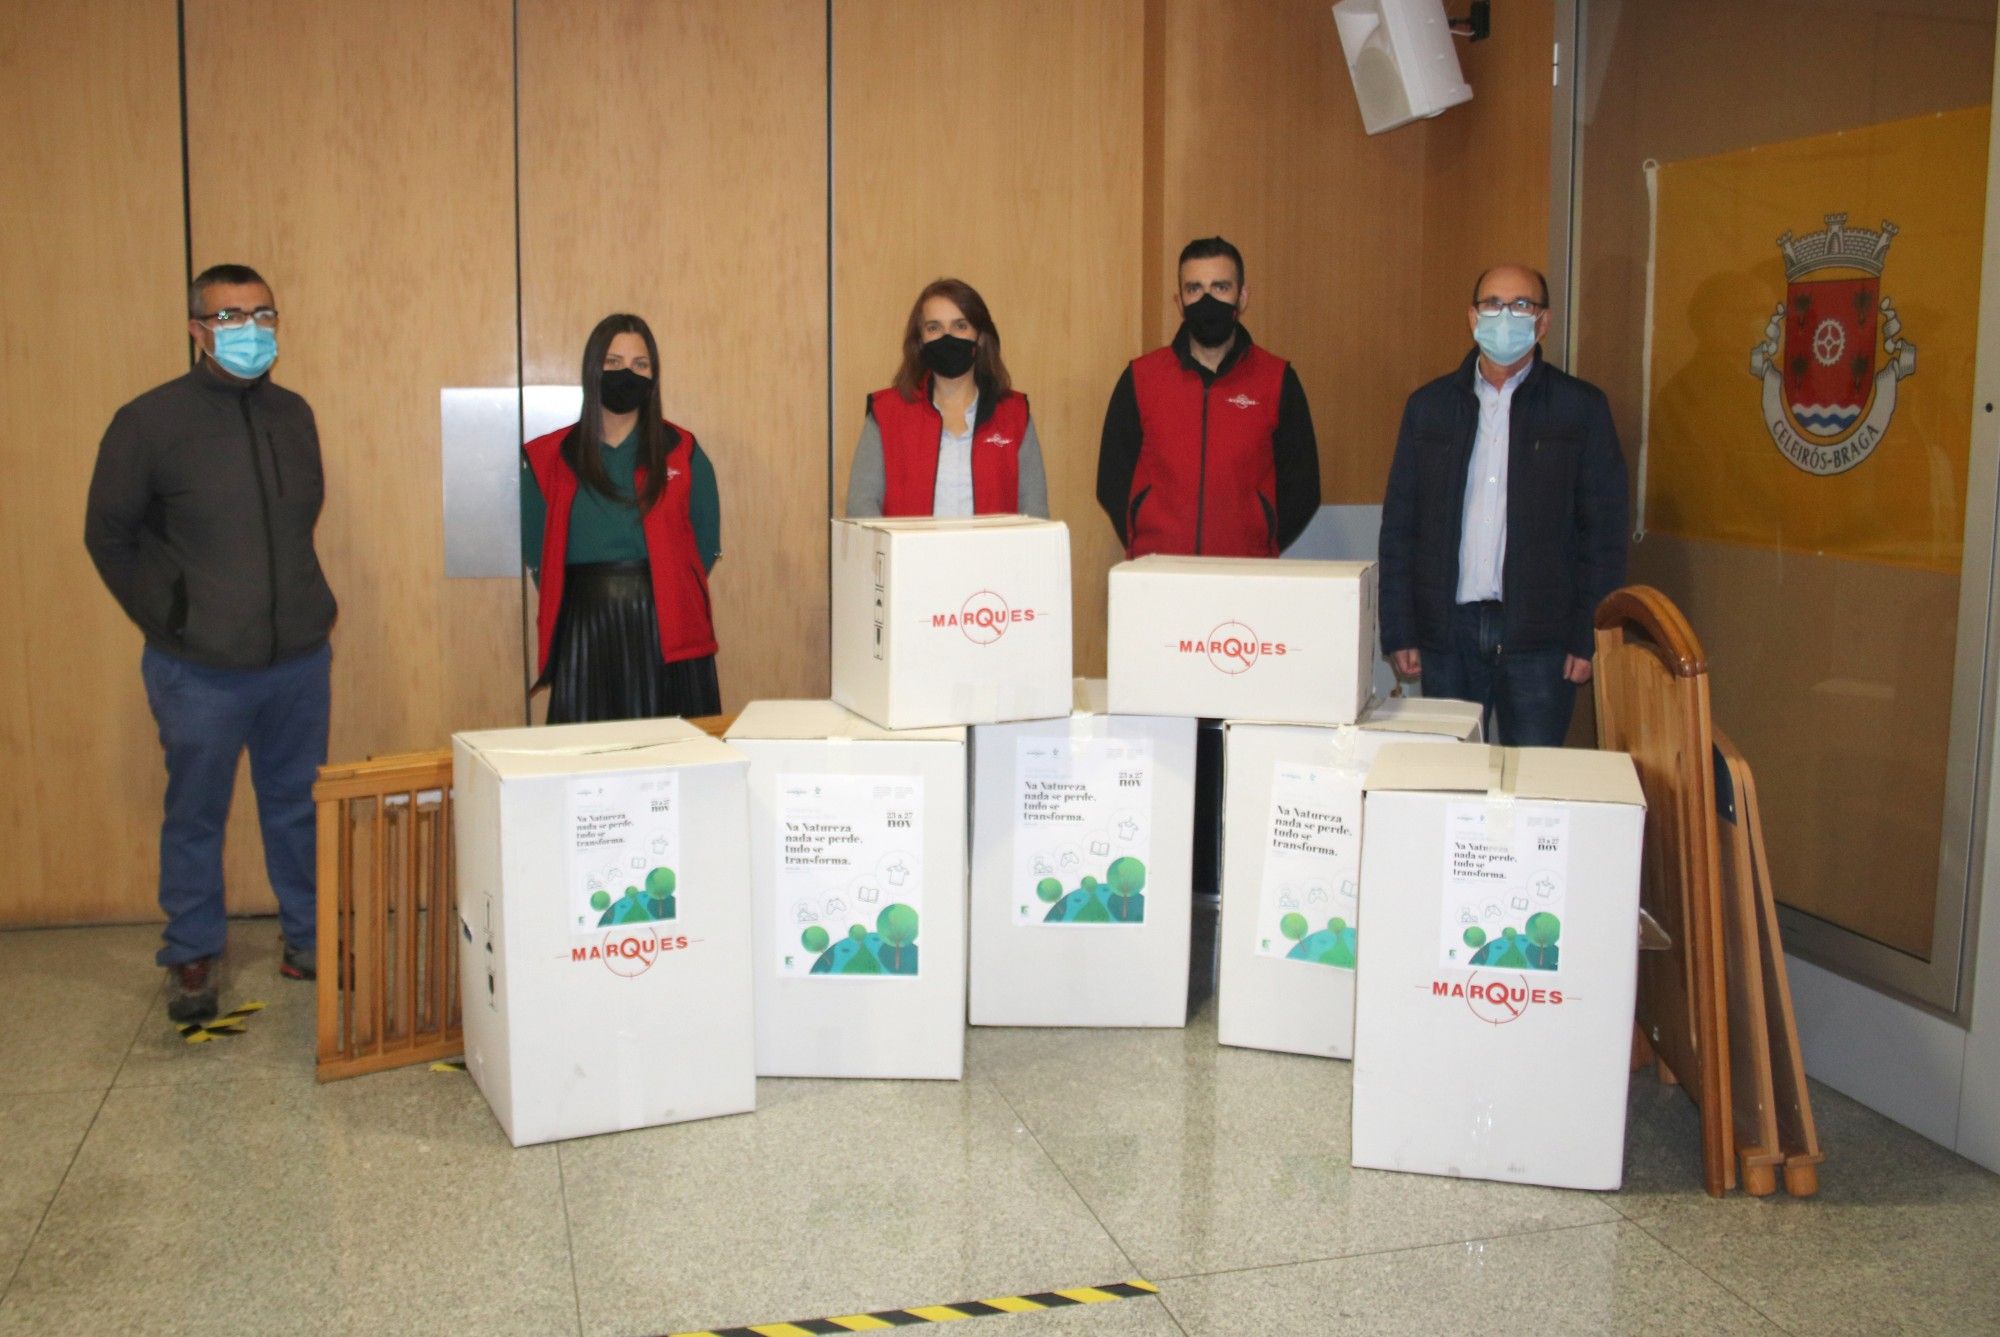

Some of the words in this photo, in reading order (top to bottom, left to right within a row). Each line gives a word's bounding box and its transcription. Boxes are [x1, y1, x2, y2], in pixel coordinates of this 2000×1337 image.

[932, 607, 1035, 636] MARQUES
[1179, 637, 1287, 667] MARQUES
[1025, 781, 1037, 790] Na
[1041, 782, 1086, 791] Natureza
[1119, 779, 1142, 787] nov
[1024, 791, 1049, 800] nada
[1024, 801, 1047, 810] tudo
[1277, 804, 1290, 816] Na
[1294, 807, 1342, 823] Natureza
[785, 822, 799, 831] Na
[802, 822, 852, 832] Natureza
[887, 819, 912, 828] nov
[1275, 818, 1302, 829] nada
[785, 833, 812, 843] nada
[814, 835, 826, 843] se
[1274, 827, 1299, 839] tudo
[785, 844, 811, 853] tudo
[1272, 838, 1338, 857] transforma.
[1537, 844, 1559, 852] nov
[1454, 851, 1476, 860] nada
[1453, 859, 1475, 868] tudo
[571, 935, 689, 967] MARQUES
[1432, 981, 1564, 1017] MARQUES
